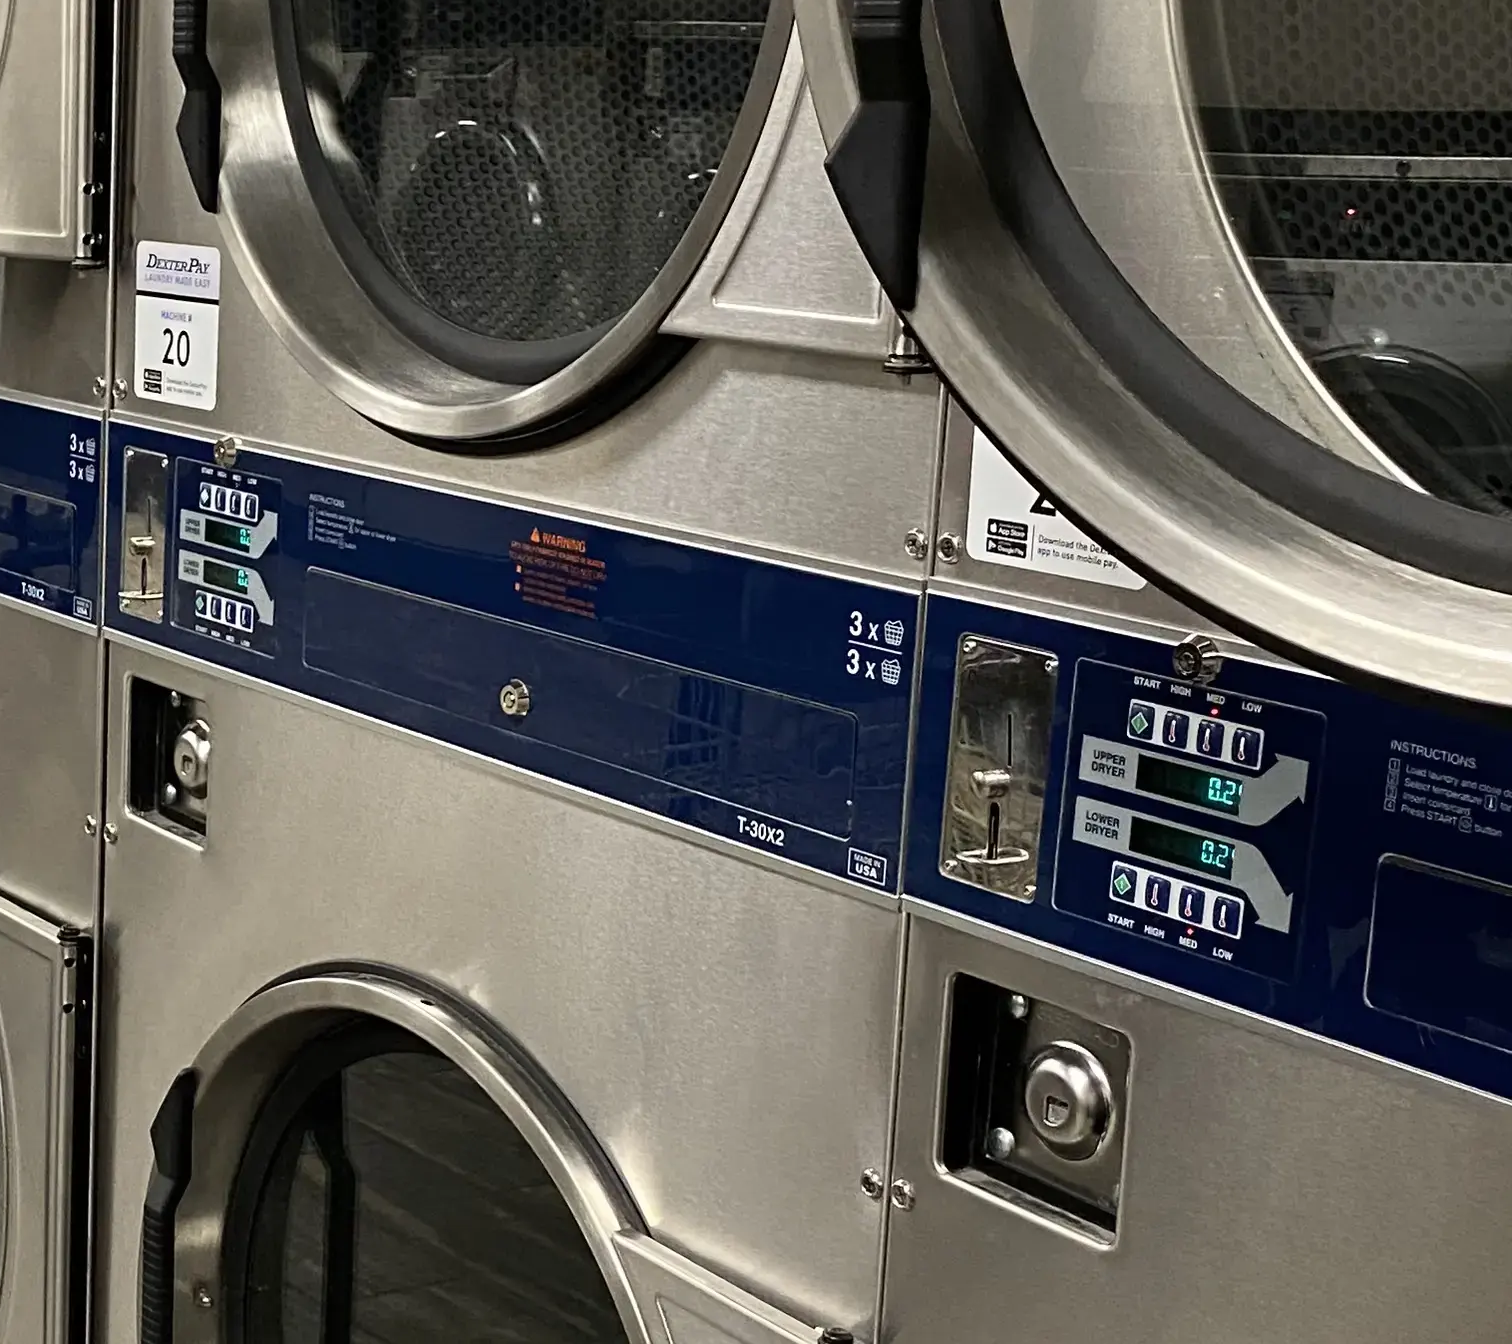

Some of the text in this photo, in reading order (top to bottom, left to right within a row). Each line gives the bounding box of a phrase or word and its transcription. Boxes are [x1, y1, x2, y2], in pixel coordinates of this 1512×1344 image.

[162, 327, 190, 367] 20
[69, 433, 77, 452] 3
[69, 460, 77, 478] 3
[542, 532, 586, 553] WARNING
[998, 527, 1010, 538] App
[1038, 534, 1075, 549] Download
[1076, 541, 1088, 551] the
[1037, 547, 1119, 570] app to use mobile pay.
[849, 611, 863, 637] 3
[846, 649, 860, 675] 3
[1133, 675, 1262, 714] START HIGH MED LOW
[1093, 749, 1126, 767] UPPER
[1390, 739, 1478, 769] INSTRUCTIONS
[1091, 762, 1126, 779] DRYER
[1085, 810, 1120, 828] LOWER
[1426, 810, 1458, 826] START
[1474, 823, 1503, 837] button
[737, 815, 785, 847] T-30X2
[1084, 822, 1119, 840] DRYER
[854, 853, 872, 866] MADE
[855, 862, 878, 880] USA
[1107, 912, 1234, 962] START HIGH MED LOW
